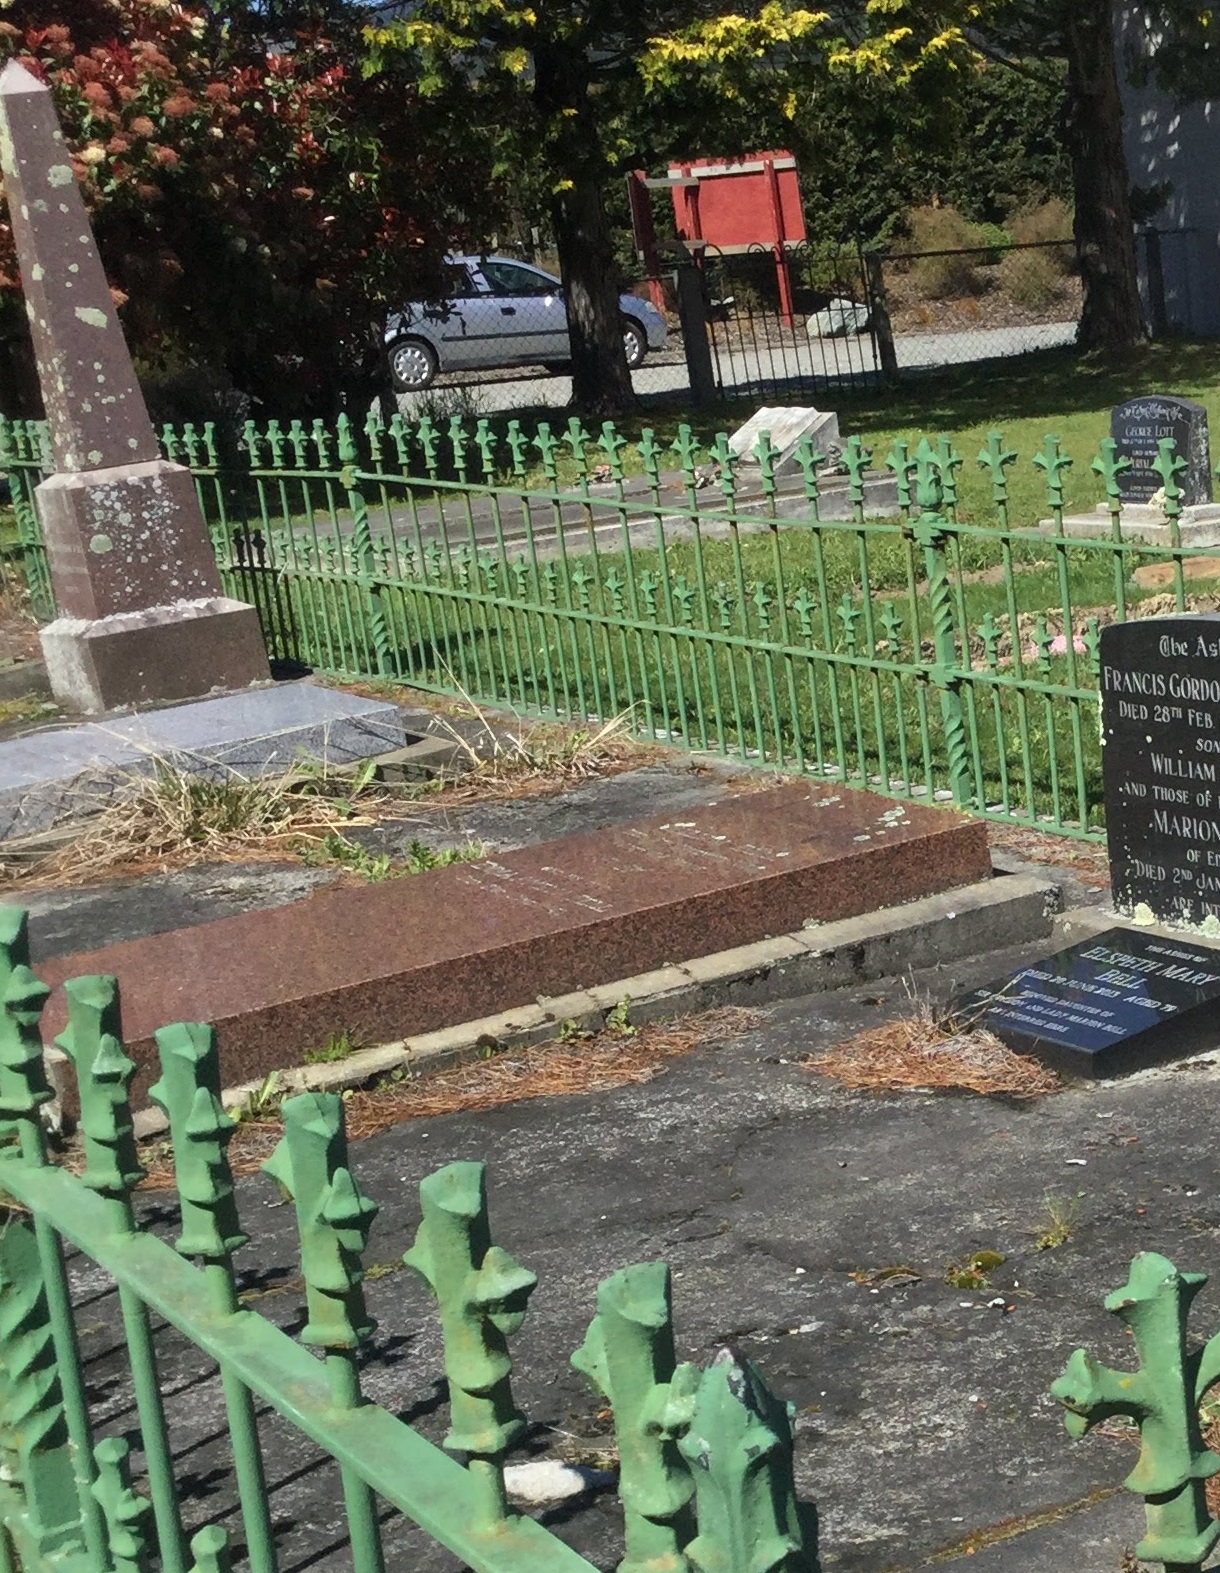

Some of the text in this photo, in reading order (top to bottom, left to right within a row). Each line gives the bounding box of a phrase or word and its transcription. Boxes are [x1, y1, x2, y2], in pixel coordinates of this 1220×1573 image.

[1155, 425, 1175, 437] LOTT
[1159, 635, 1188, 657] The
[1103, 666, 1166, 697] FRANCIS
[1119, 701, 1149, 720] DIED
[1151, 752, 1216, 782] WILLIAM
[1123, 782, 1147, 798] AND
[1152, 785, 1190, 805] THOSE
[1196, 792, 1213, 807] OF
[1187, 849, 1201, 863] OF
[1135, 859, 1166, 881] DIED
[1172, 867, 1193, 884] 2ND
[1170, 895, 1194, 913] ARE
[1079, 946, 1220, 985] ELSPETH MARY
[1094, 969, 1148, 989] BELL
[1123, 995, 1162, 1009] AGED
